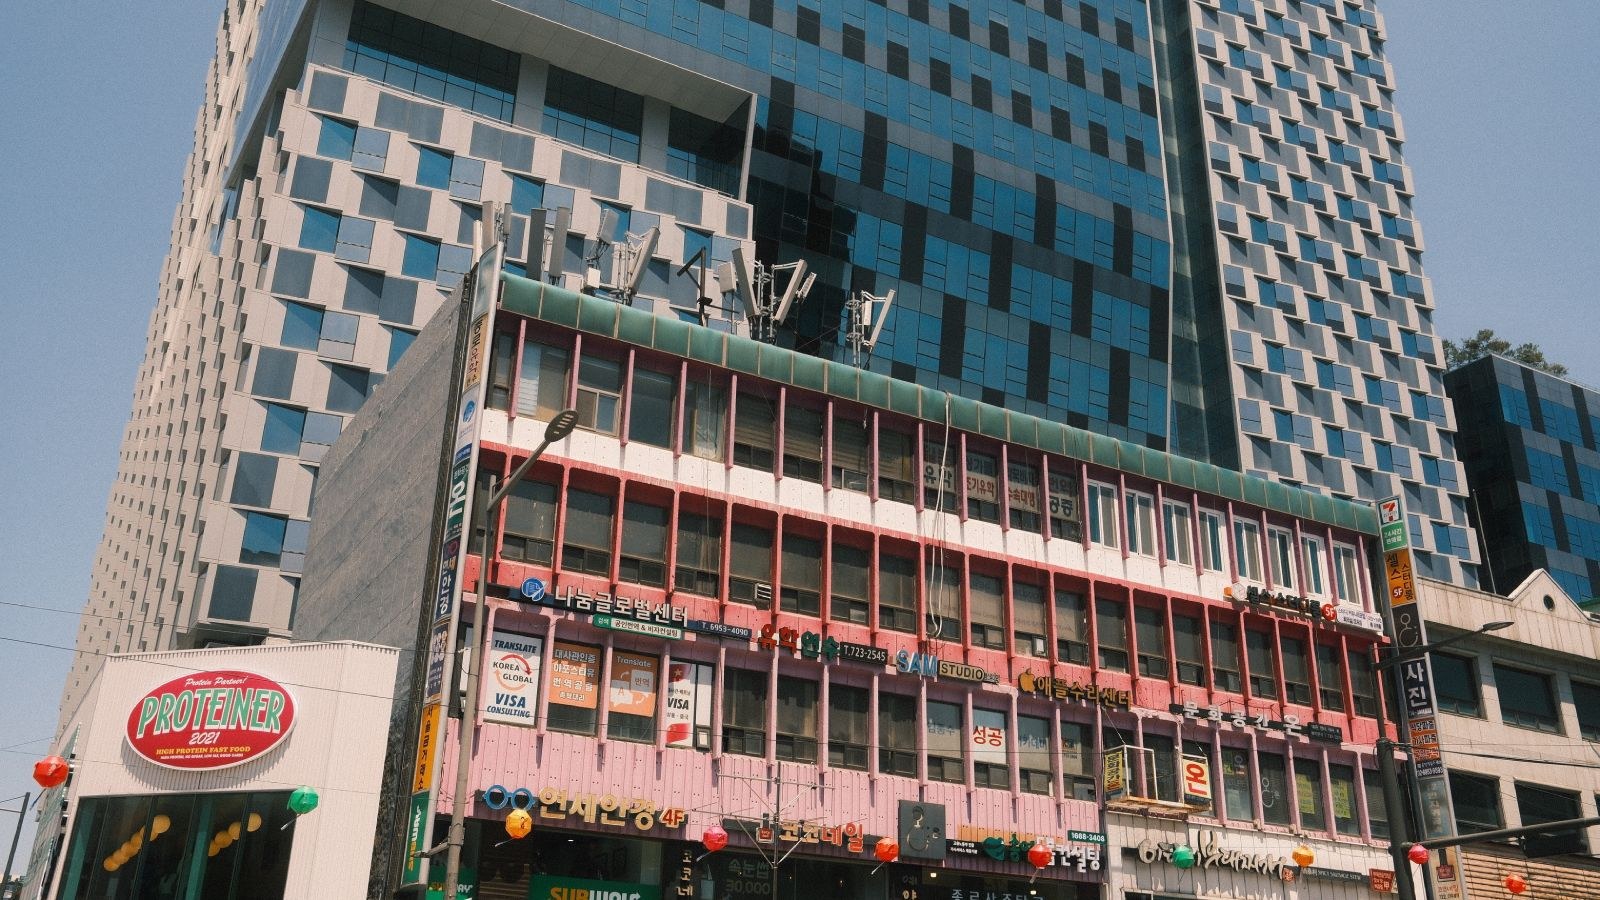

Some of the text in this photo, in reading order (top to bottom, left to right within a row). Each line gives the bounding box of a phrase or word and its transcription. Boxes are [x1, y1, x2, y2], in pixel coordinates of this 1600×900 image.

[555, 585, 688, 628] 나눔글로벌센터
[1325, 606, 1335, 618] SF
[710, 623, 749, 637] 6953-4090
[494, 640, 537, 654] TRANSLATE
[554, 648, 596, 663] 대사관인증
[616, 656, 652, 668] Translate
[492, 661, 520, 672] KOREA
[553, 663, 595, 677] 아포스티유
[896, 649, 938, 678] SAM
[941, 662, 984, 681] STUDIO
[185, 675, 248, 687] Protein Partner!
[503, 673, 534, 684] GLOBAL
[634, 677, 650, 687] 번역
[1406, 662, 1427, 708] 사진
[617, 687, 625, 696] A
[1037, 675, 1133, 711] 애플수리센터
[495, 693, 526, 708] VISA
[667, 697, 689, 711] VISA
[136, 688, 285, 739] PROTEINER
[486, 705, 531, 718] CONSULTING
[1184, 700, 1271, 732] 문화공간
[1284, 714, 1302, 737] 온
[188, 731, 221, 745] 2021
[973, 725, 1003, 747] 성공
[1186, 763, 1208, 796] 온
[539, 786, 657, 831] 연세안경
[661, 808, 685, 827] 4F
[778, 821, 864, 853] 코코네일
[726, 880, 771, 895] 30,000
